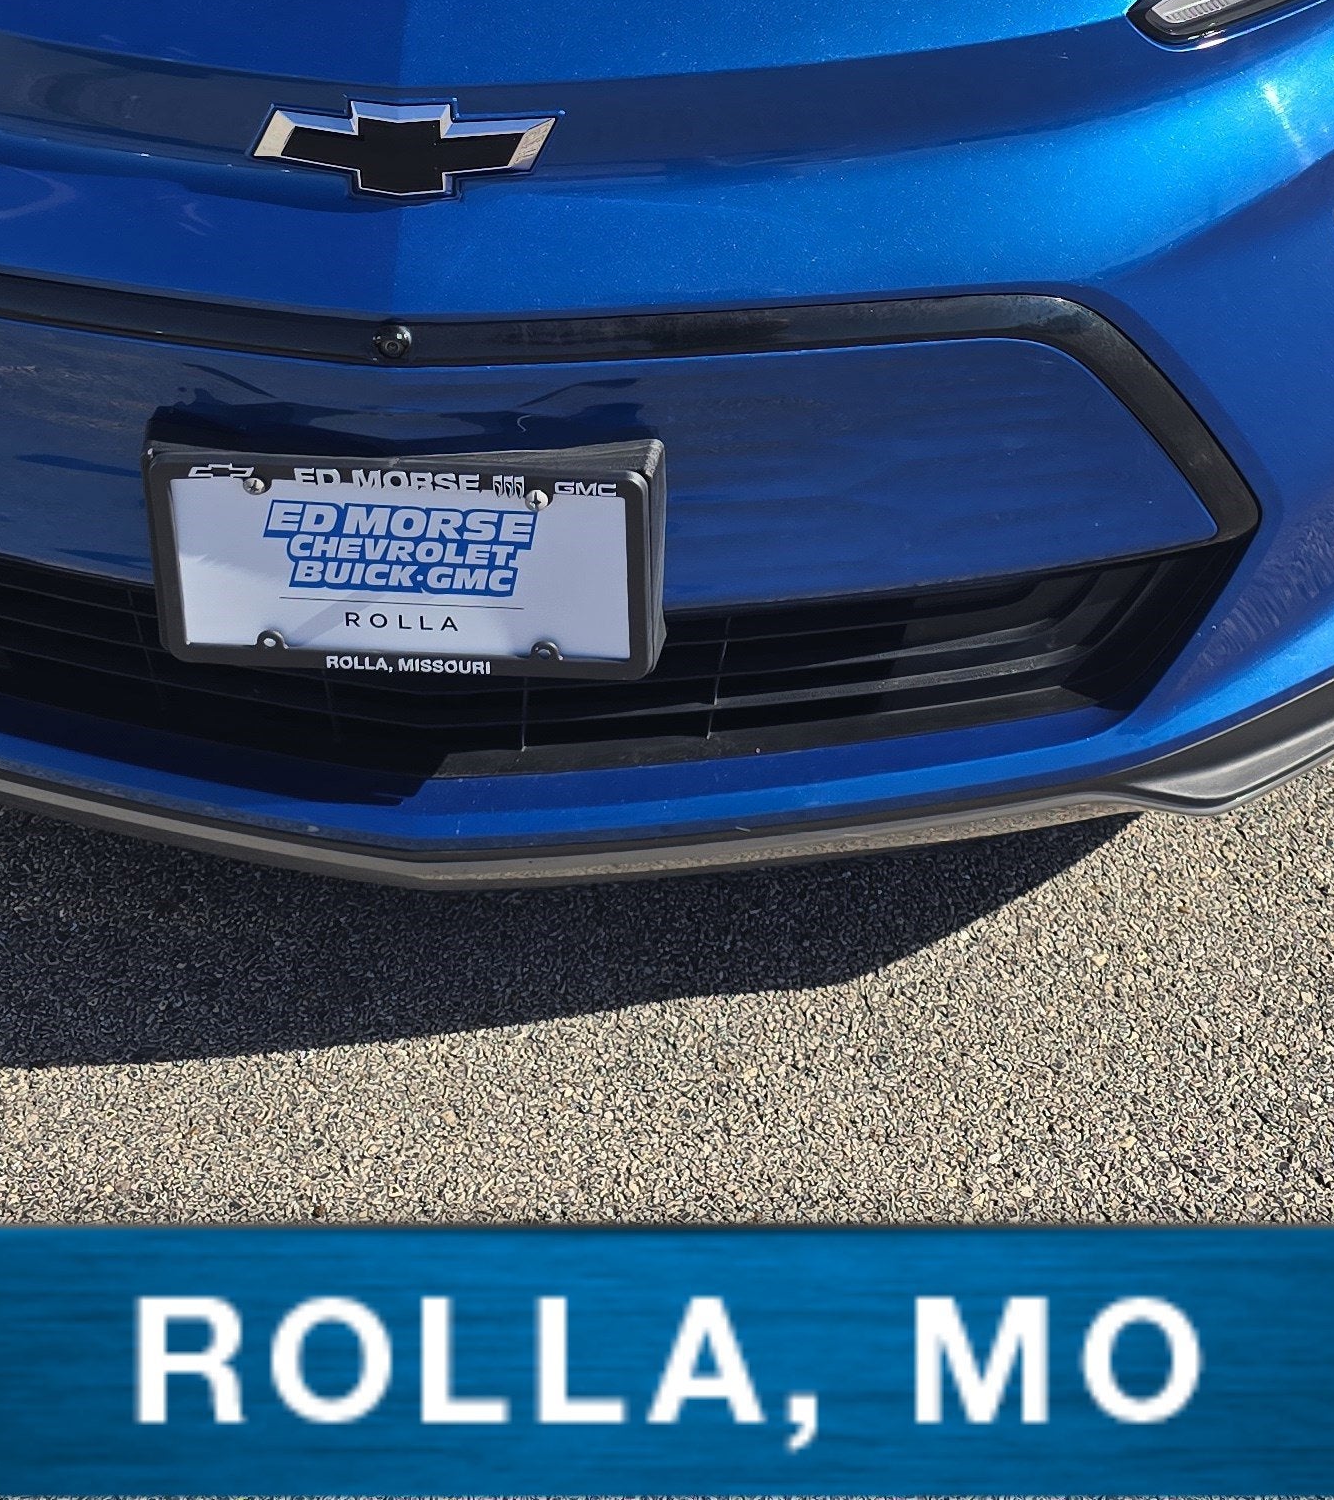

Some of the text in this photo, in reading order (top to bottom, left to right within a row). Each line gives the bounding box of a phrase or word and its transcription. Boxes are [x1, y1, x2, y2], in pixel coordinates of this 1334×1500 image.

[293, 467, 617, 497] ED MORSE GMC
[267, 501, 535, 543] ED MORSE
[289, 534, 515, 567] CHEVROLET
[344, 611, 459, 632] ROLLA
[325, 655, 492, 675] ROLLA, MISSOURI
